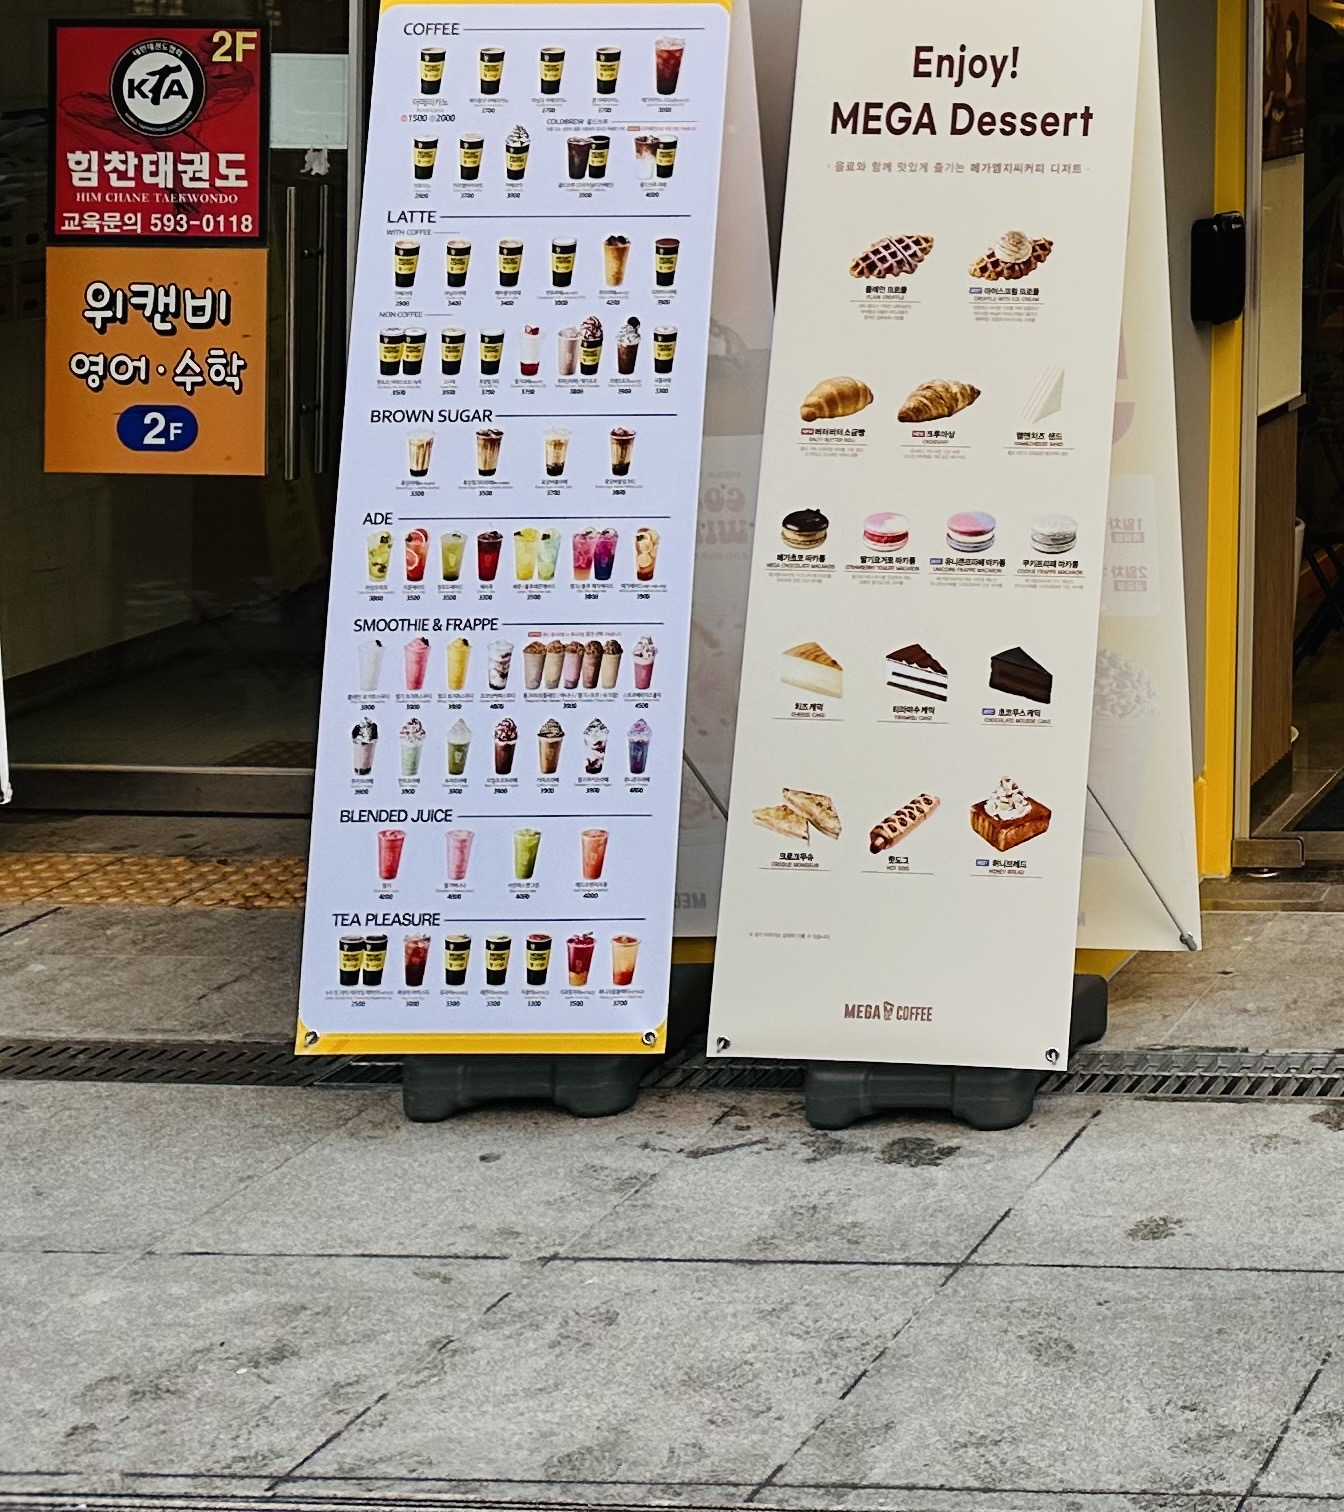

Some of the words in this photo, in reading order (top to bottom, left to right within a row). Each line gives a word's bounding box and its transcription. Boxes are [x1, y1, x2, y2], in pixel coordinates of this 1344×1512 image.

[403, 22, 461, 36] COFFEE
[211, 29, 258, 65] 2F
[912, 43, 1021, 88] Enjoy!
[127, 64, 189, 106] KTA
[830, 101, 937, 136] MEGA
[949, 102, 1094, 137] Dessert
[66, 149, 249, 189] 힘찬태권도
[897, 161, 929, 173] 맛있게
[75, 191, 102, 203] HIM
[105, 191, 151, 203] CHANE
[153, 192, 239, 204] TAEKWONDO
[60, 211, 142, 234] 교육문의
[149, 213, 253, 233] 593-0118
[386, 210, 437, 224] LATTE
[82, 281, 231, 332] 위캔비
[370, 409, 434, 423] BROWN
[437, 408, 493, 423] SUGAR
[141, 413, 185, 445] 2F
[363, 512, 394, 525] ADE
[353, 618, 430, 632] SMOOTHIE
[432, 618, 443, 631] &
[445, 618, 499, 631] FRAPPE
[340, 809, 409, 823] BLENDED
[410, 809, 453, 823] JUICE
[332, 913, 362, 927] TEA
[365, 913, 441, 927] PLEASURE
[844, 1003, 881, 1020] MEGA
[896, 1005, 933, 1022] COFFEE
